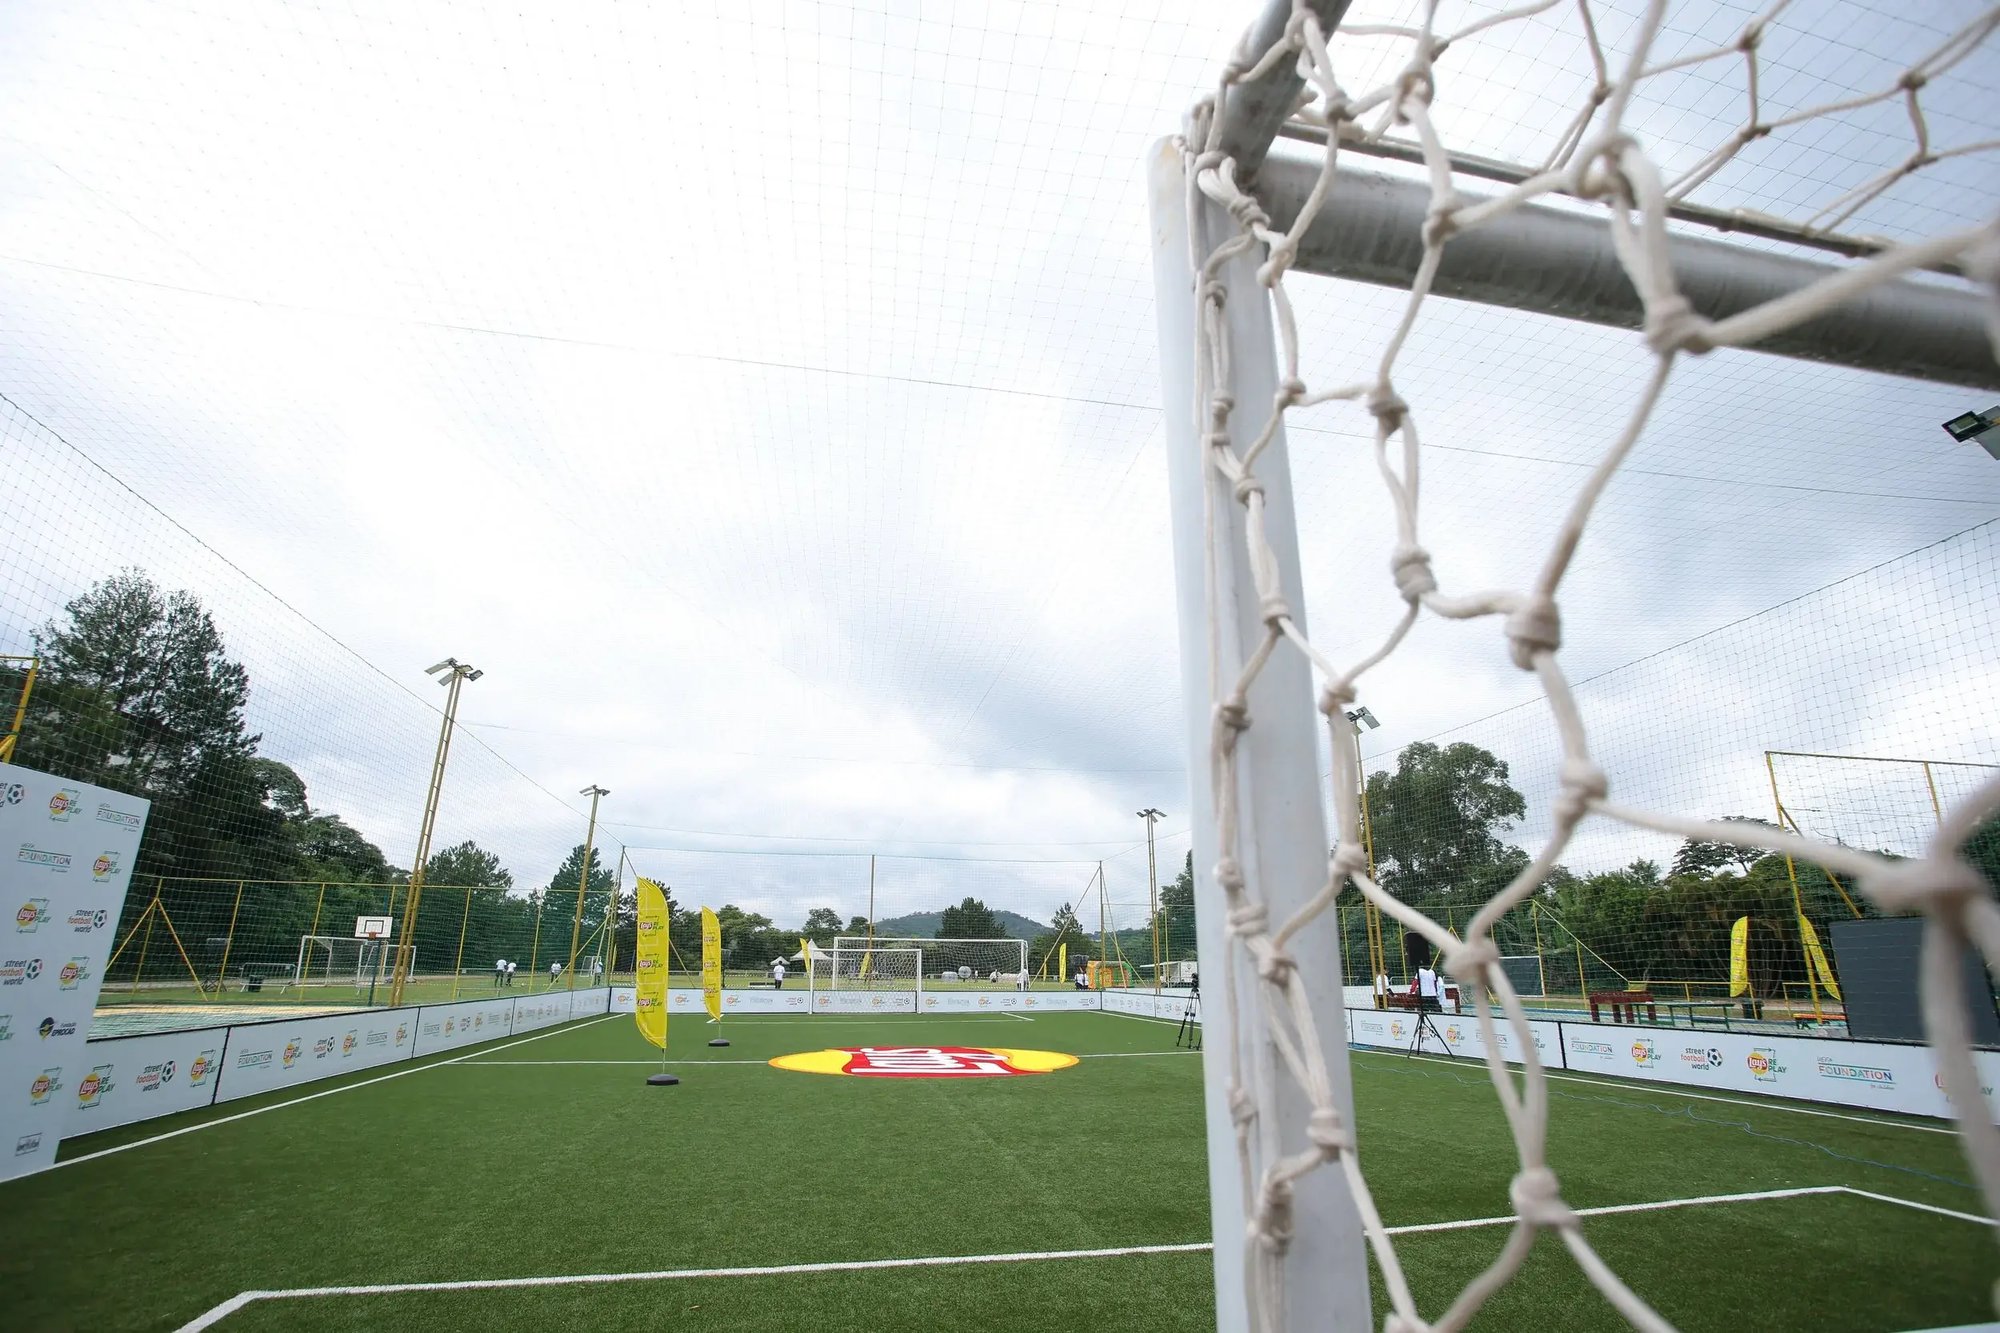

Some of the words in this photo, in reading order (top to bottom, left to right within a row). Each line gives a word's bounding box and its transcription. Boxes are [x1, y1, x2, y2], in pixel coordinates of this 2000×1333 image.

[97, 810, 140, 826] FOUNDATION
[18, 851, 72, 865] FOUNDATION
[75, 909, 94, 917] street
[67, 916, 92, 925] football
[74, 925, 92, 933] world
[4, 960, 27, 968] street
[3, 977, 25, 985] world
[1571, 1043, 1613, 1053] FOUNDATION
[1685, 1047, 1705, 1055] street
[1681, 1054, 1705, 1063] football
[144, 1064, 162, 1073] street
[1768, 1066, 1787, 1074] PLAY
[1819, 1065, 1893, 1081] FOUNDATION
